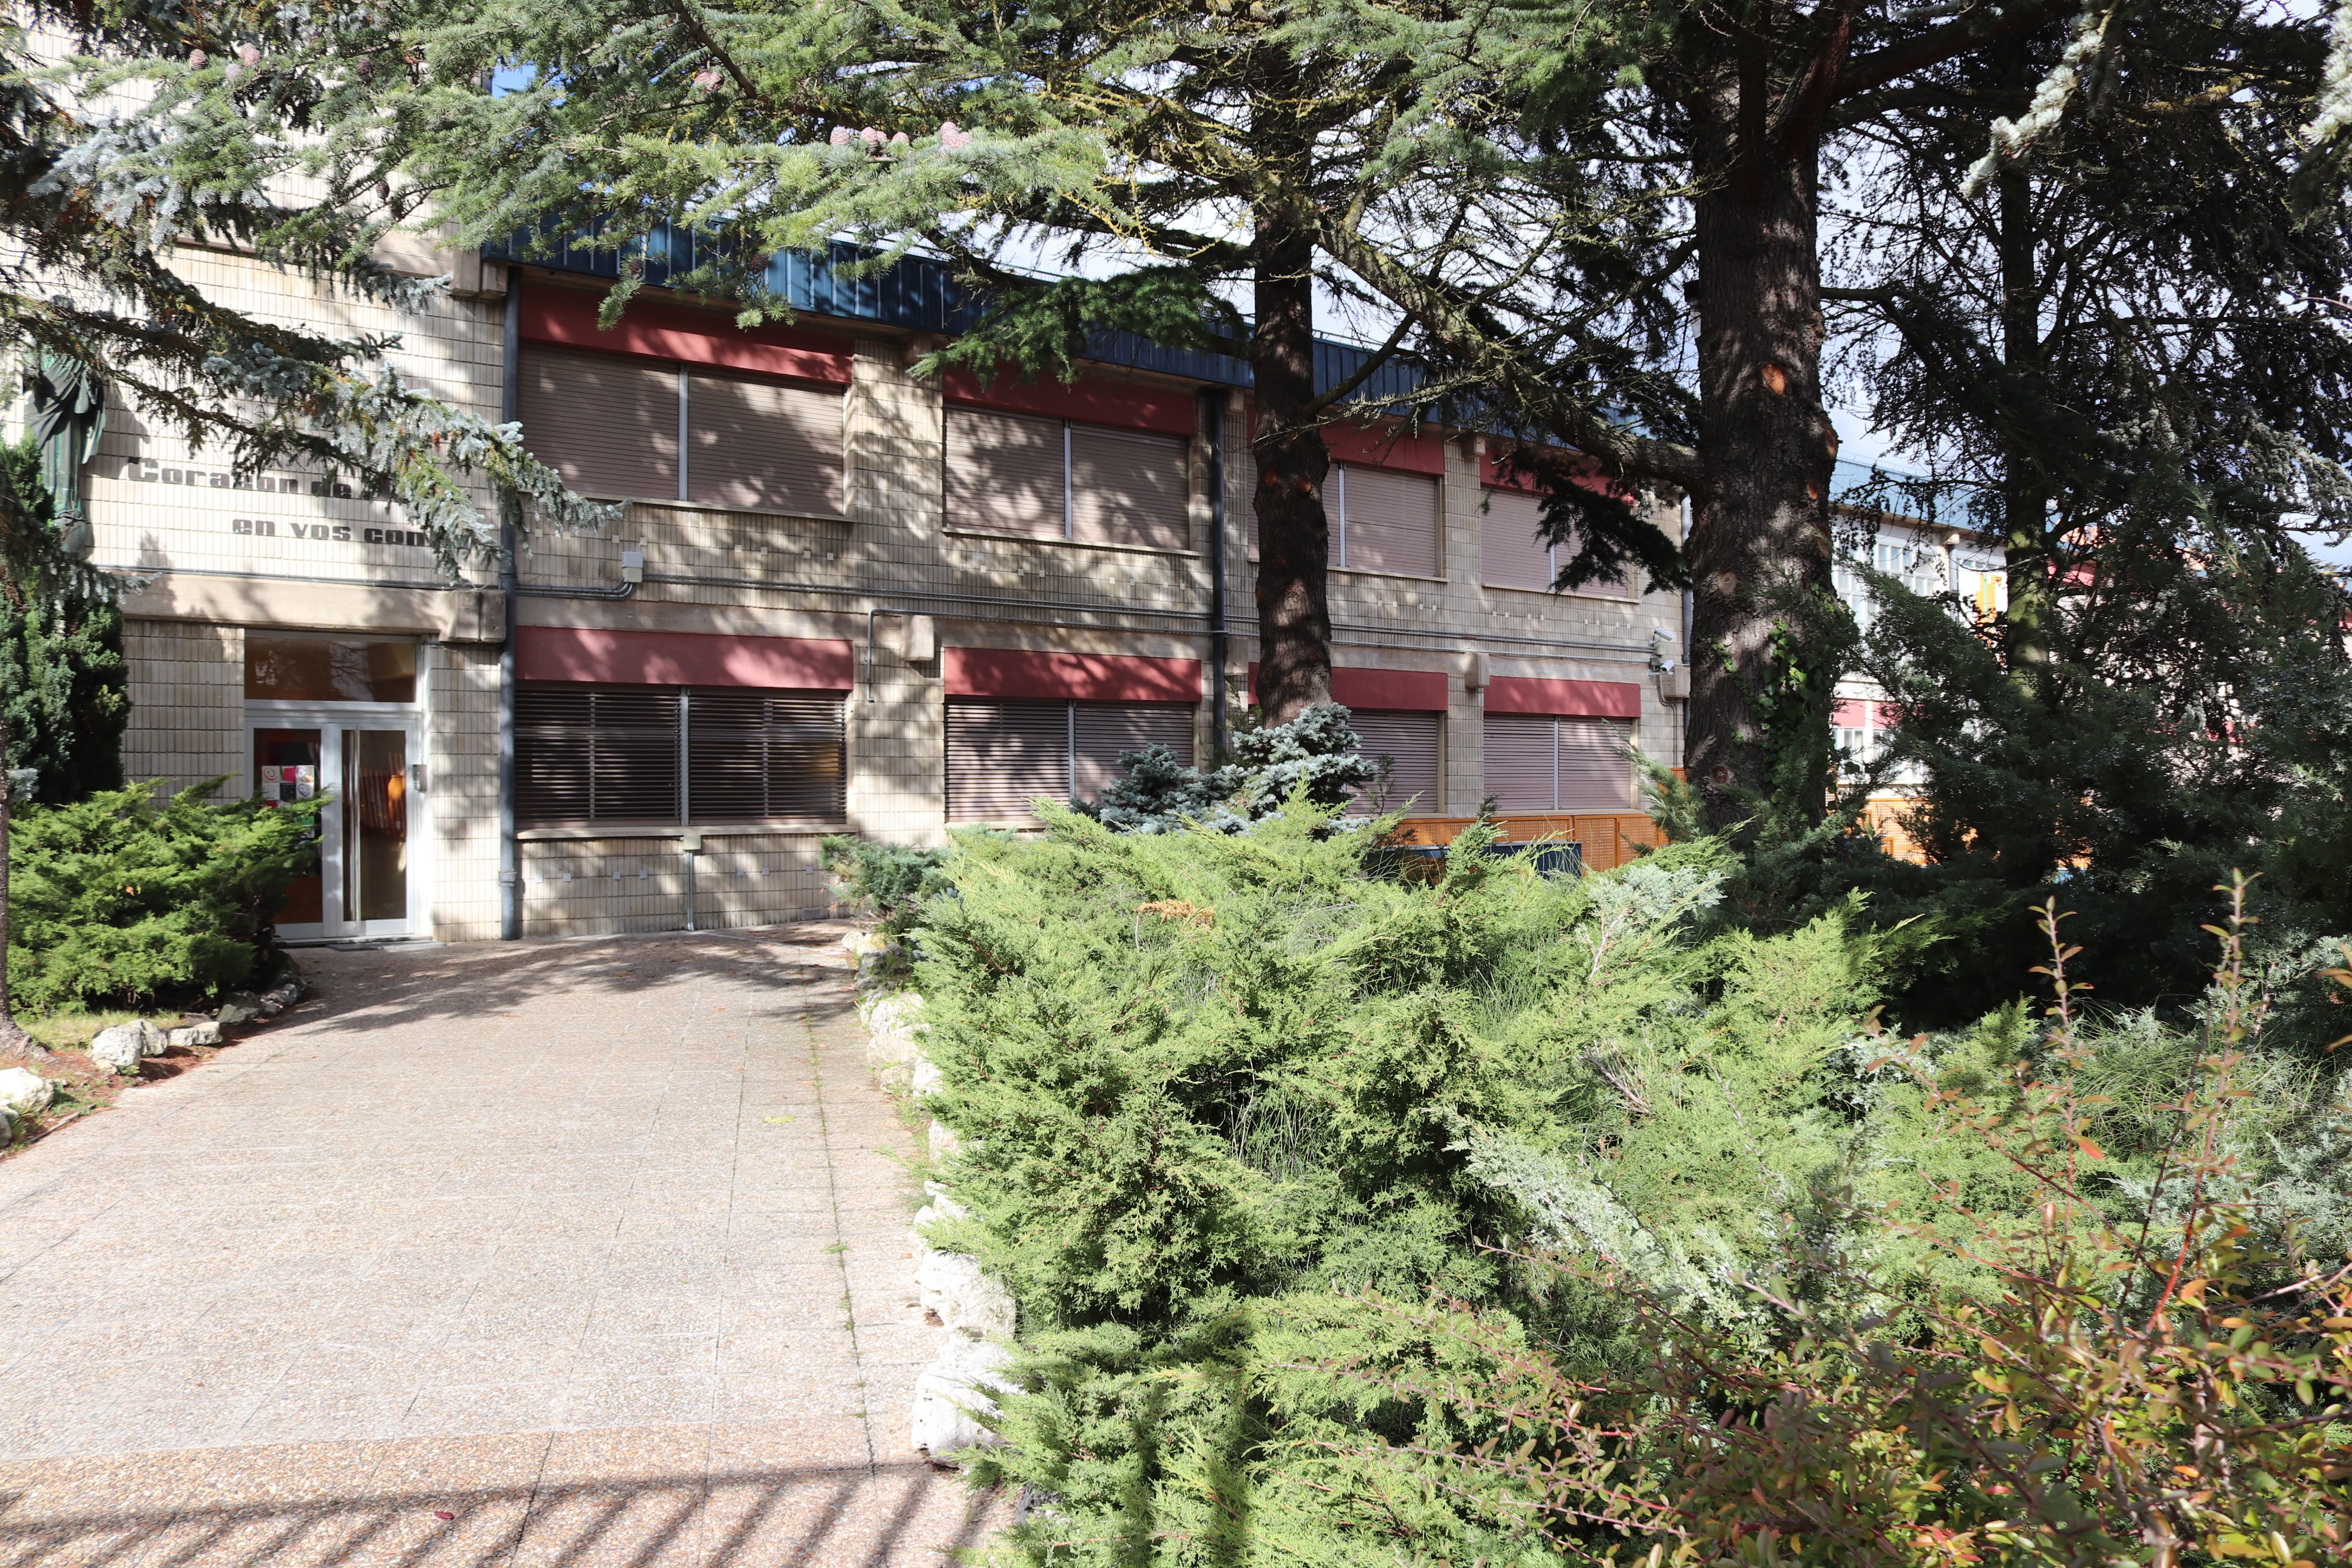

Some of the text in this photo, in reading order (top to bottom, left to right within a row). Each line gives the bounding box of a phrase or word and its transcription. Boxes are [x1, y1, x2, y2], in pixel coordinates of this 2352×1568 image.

[311, 474, 351, 498] de
[232, 519, 434, 546] en vos con
